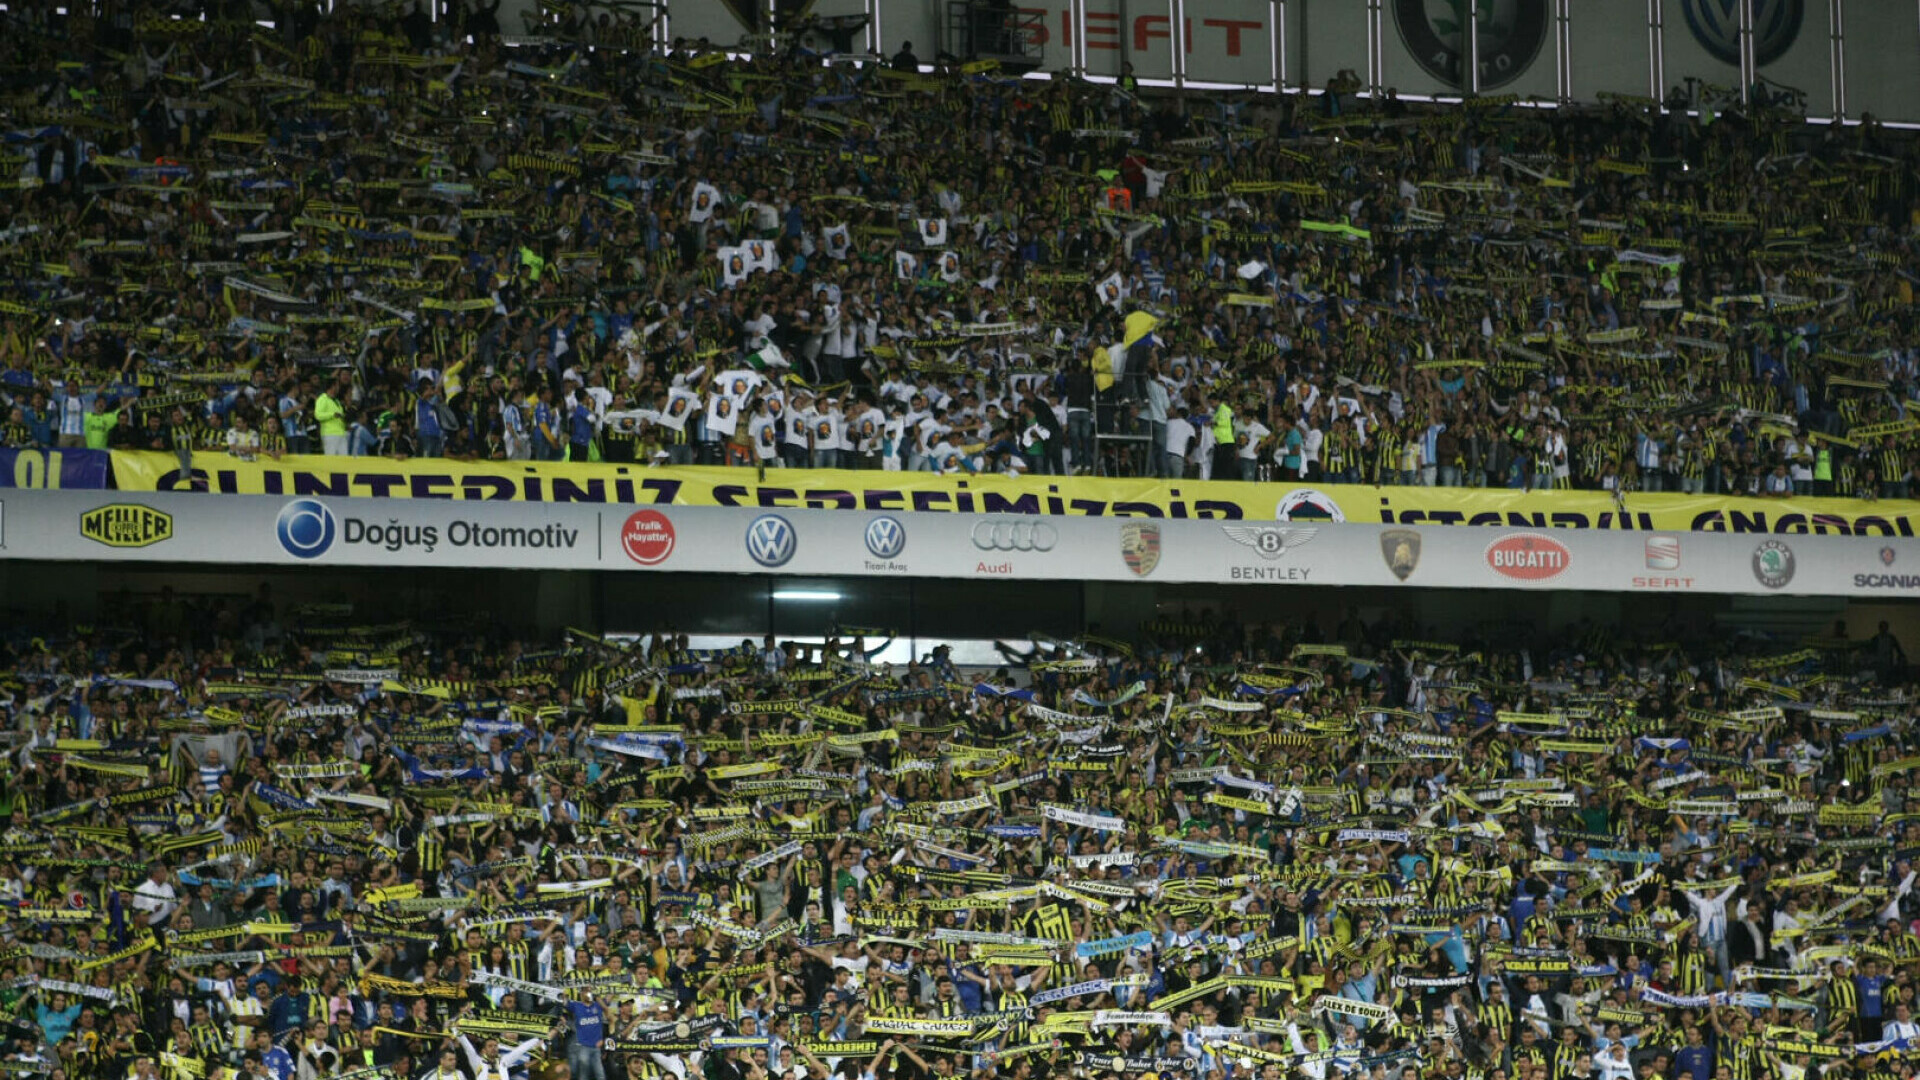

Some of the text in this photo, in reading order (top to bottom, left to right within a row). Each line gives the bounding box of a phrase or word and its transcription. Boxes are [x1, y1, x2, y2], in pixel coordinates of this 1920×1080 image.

[1004, 8, 1262, 56] SEAT
[86, 508, 167, 542] MEILLER
[635, 520, 662, 531] Trafik
[344, 517, 579, 552] Doğuş Otomotiv
[1494, 551, 1562, 568] BUGATTI
[976, 562, 1013, 574] Audi
[1231, 566, 1311, 580] BENTLEY
[1632, 576, 1695, 588] SEAT
[1854, 574, 1920, 588] SCANIA
[1079, 761, 1107, 770] ALEX
[1539, 961, 1569, 971] ALEX
[1323, 998, 1387, 1019] ALEX DE SOUZA
